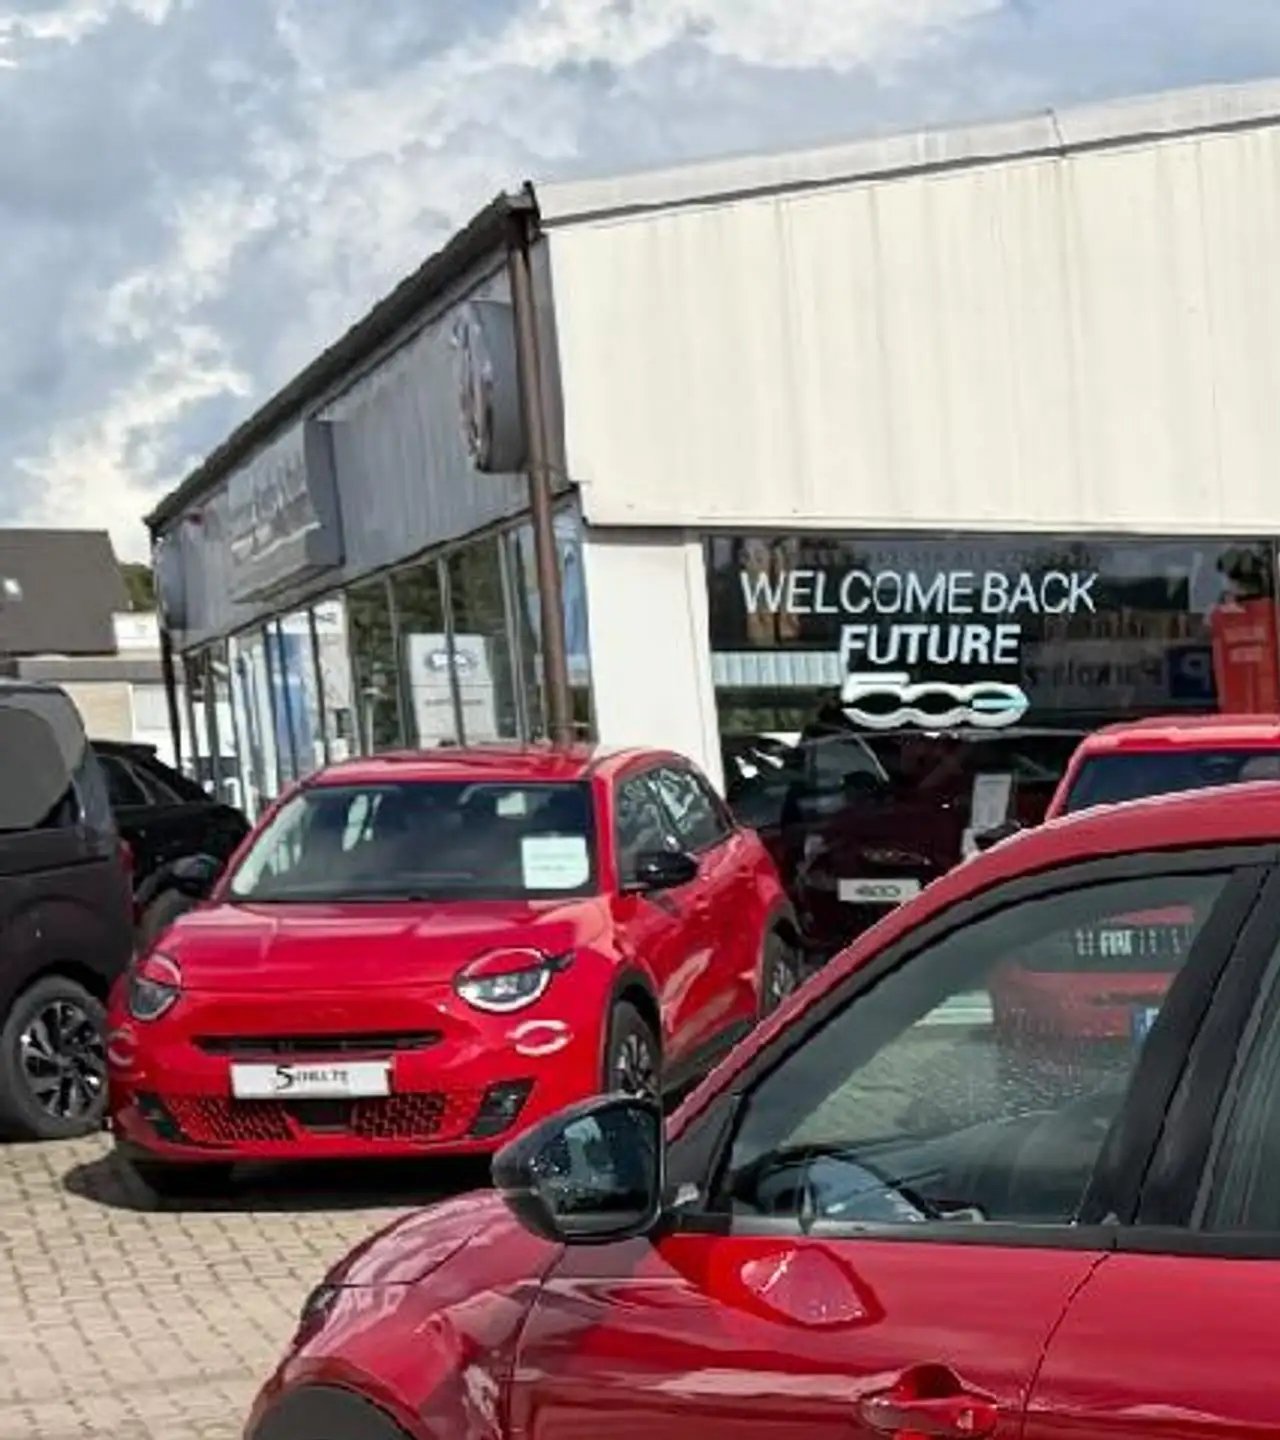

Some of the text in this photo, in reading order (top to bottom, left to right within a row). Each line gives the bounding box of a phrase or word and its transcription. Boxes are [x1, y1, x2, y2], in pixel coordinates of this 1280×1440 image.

[739, 570, 1100, 614] WELCOME BACK
[840, 624, 1022, 665] FUTURE
